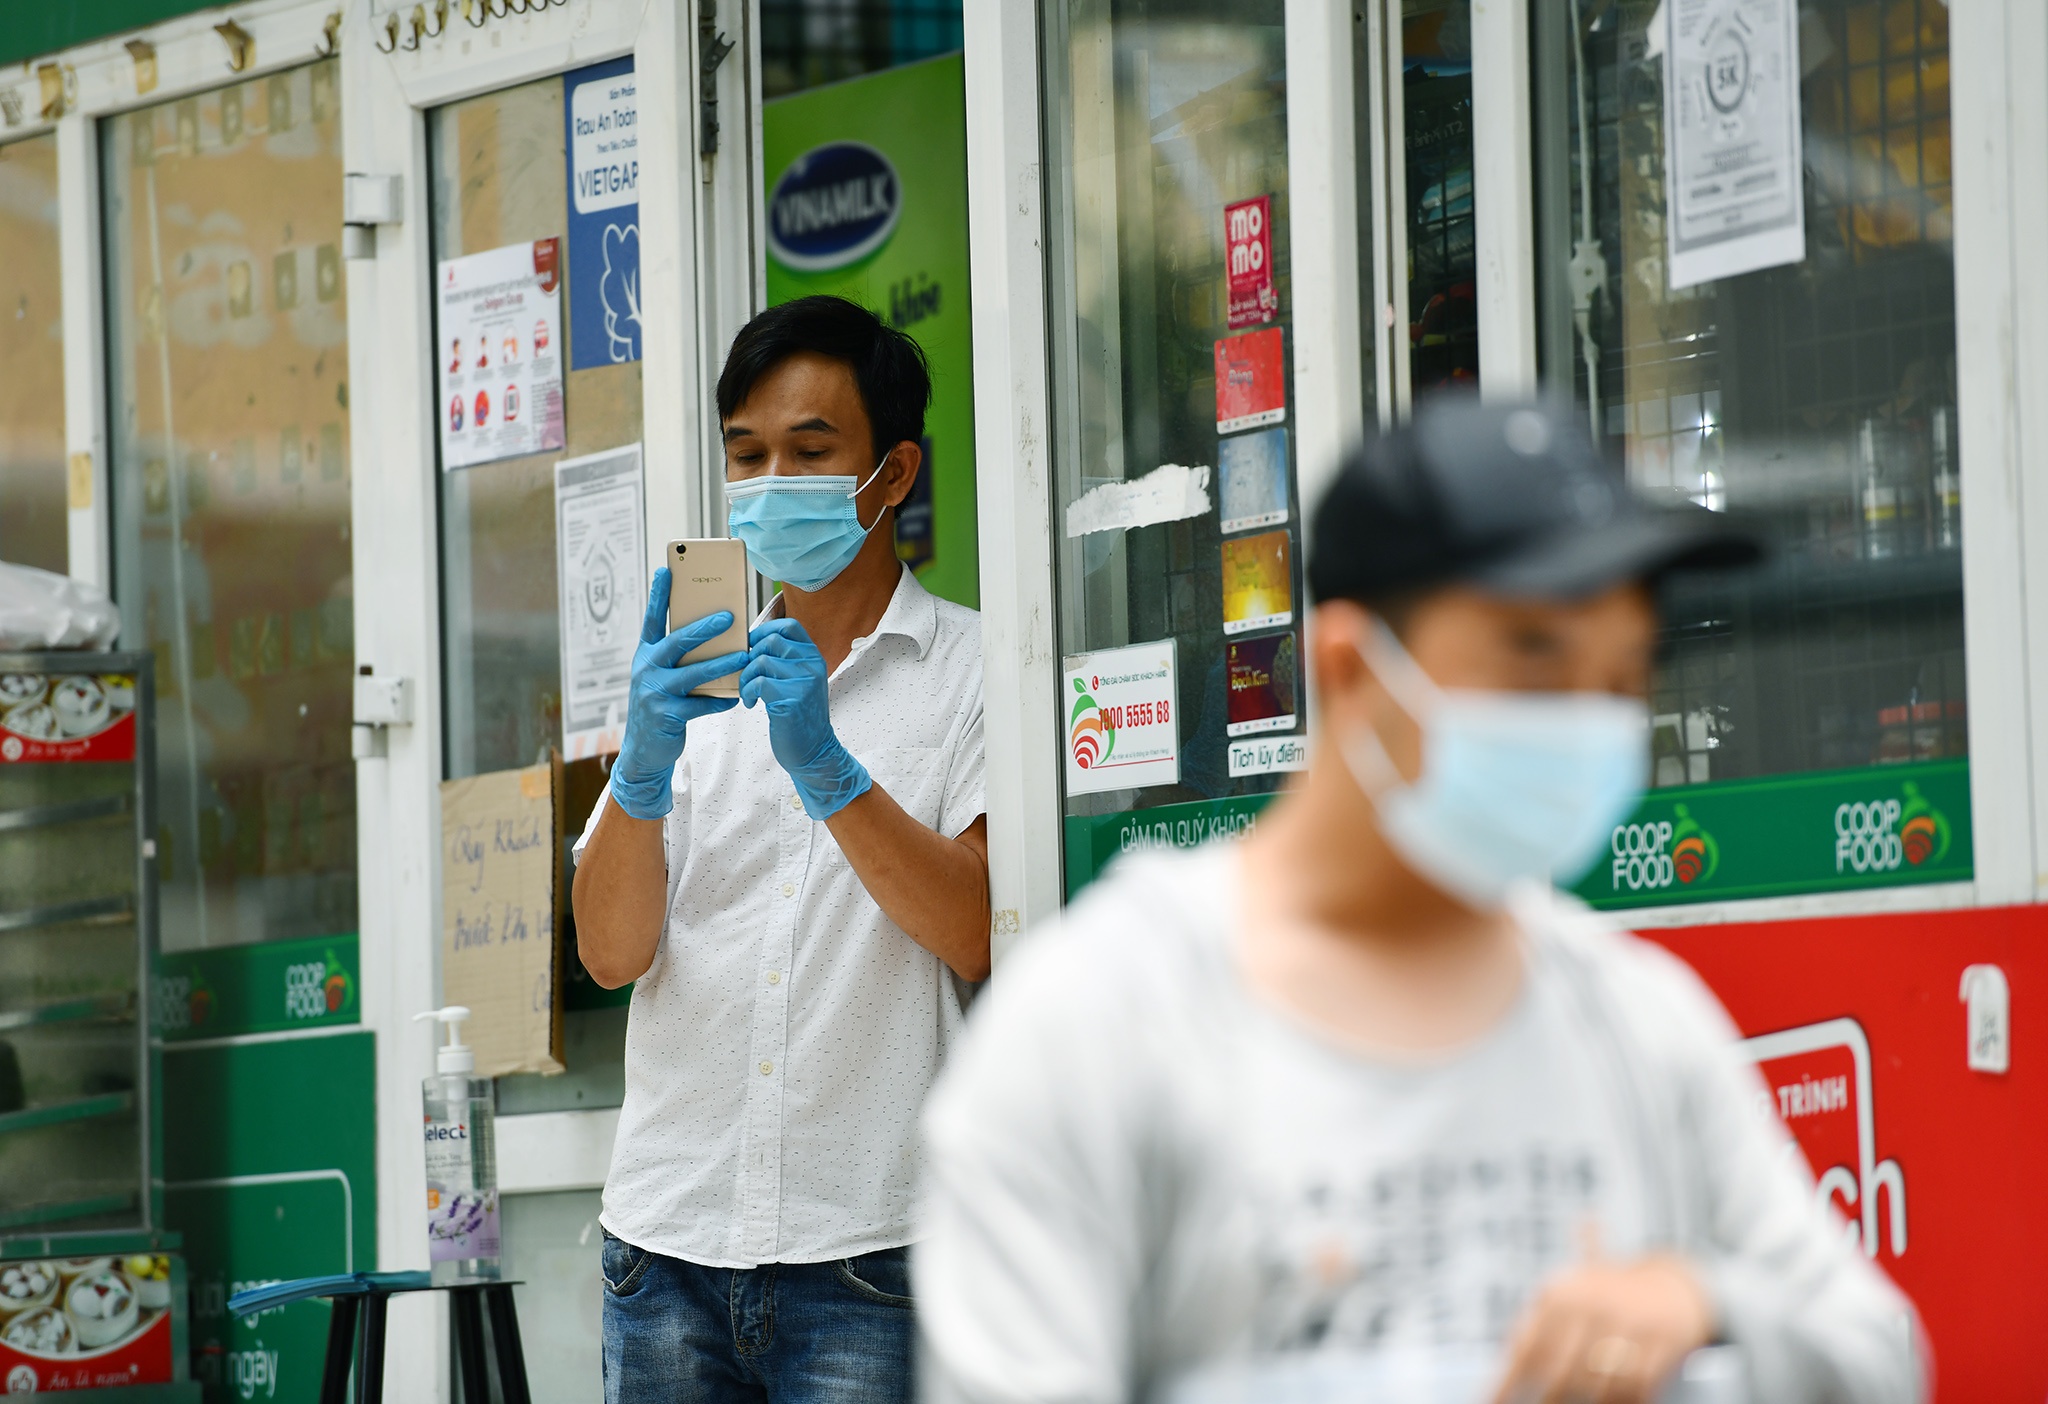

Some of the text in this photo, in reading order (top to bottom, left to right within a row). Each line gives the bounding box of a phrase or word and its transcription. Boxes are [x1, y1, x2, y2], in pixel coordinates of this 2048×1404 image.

[576, 106, 637, 136] Rau An Toàn
[578, 160, 638, 198] VIETGAP
[777, 171, 893, 238] VINAMILK
[1098, 700, 1170, 732] 1900 5555 68
[1232, 748, 1255, 769] Tích
[1276, 741, 1305, 764] điểm
[1177, 811, 1205, 848] QUÝ
[1208, 808, 1256, 844] KHÁCH
[1834, 799, 1901, 838] COOP
[1611, 820, 1673, 858] COOP
[1836, 832, 1902, 875] FOOD
[1612, 854, 1674, 891] FOOD
[285, 962, 326, 988] COOP
[285, 986, 327, 1020] FOOD
[1776, 1073, 1848, 1118] TRÌNH
[226, 1338, 279, 1400] ngày
